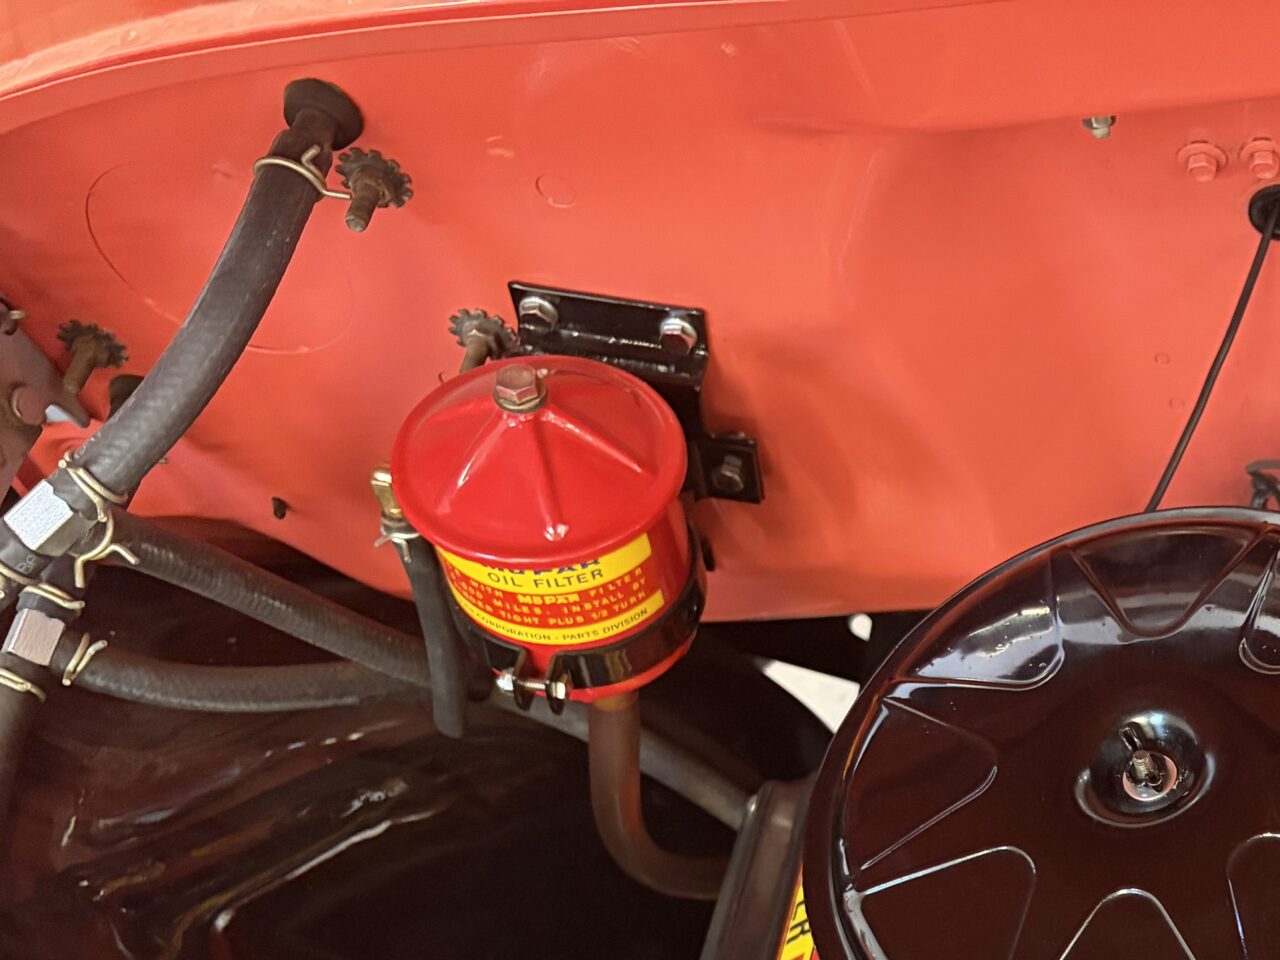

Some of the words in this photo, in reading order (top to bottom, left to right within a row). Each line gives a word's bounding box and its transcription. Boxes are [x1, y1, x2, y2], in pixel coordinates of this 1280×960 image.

[470, 579, 504, 598] WITH
[589, 567, 642, 597] FILTER
[487, 572, 523, 588] OIL
[533, 568, 604, 588] FILTER
[563, 591, 624, 614] INSTALL
[548, 615, 585, 626] PLUS
[591, 609, 608, 620] 1/2
[562, 629, 600, 641] PARTS
[602, 608, 648, 633] DIVISION
